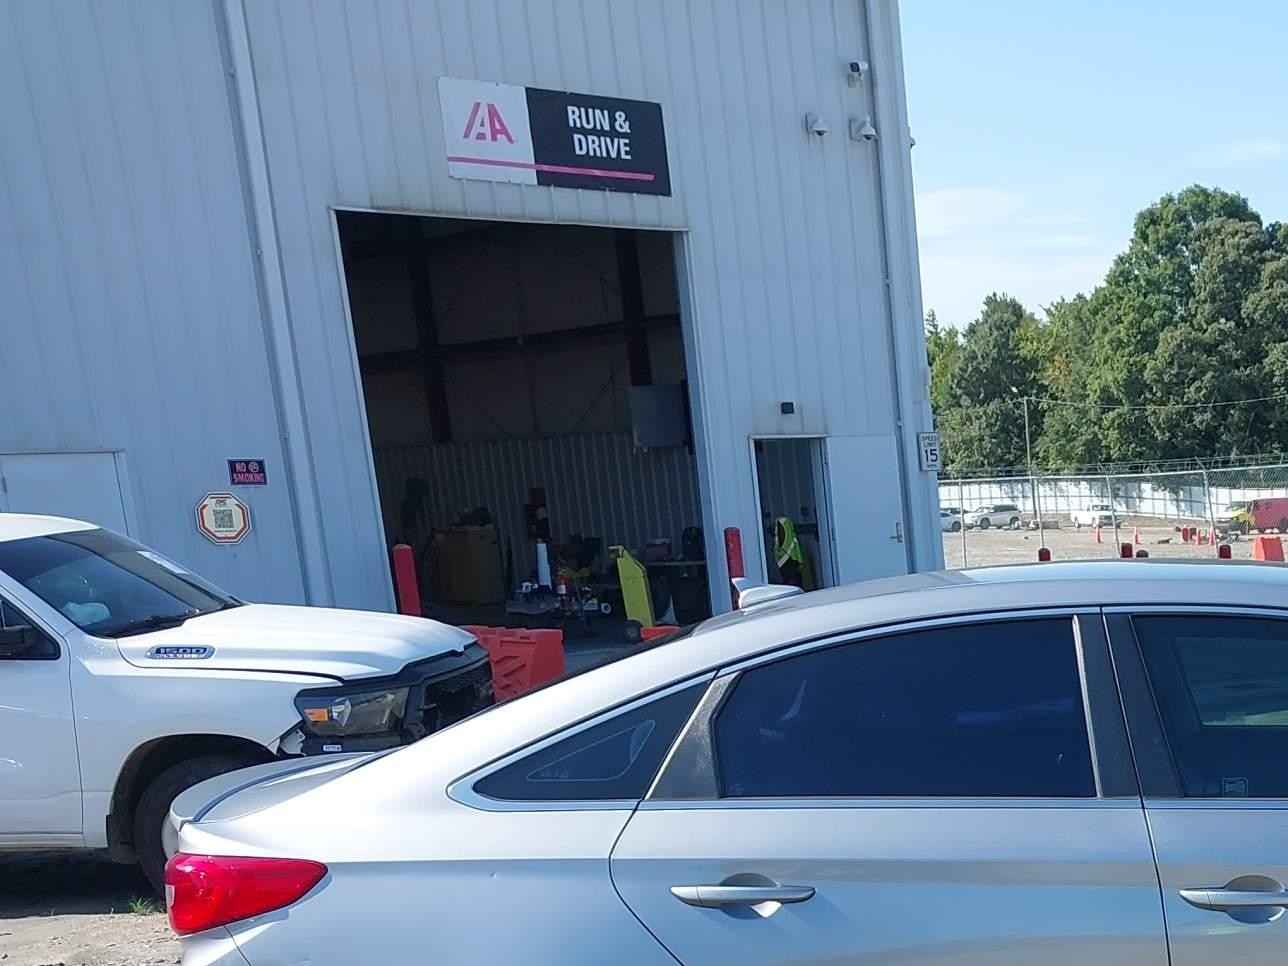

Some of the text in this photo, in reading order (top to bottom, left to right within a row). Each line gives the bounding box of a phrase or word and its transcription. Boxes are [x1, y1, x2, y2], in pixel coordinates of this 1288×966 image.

[566, 105, 632, 134] RUN &
[573, 133, 632, 160] DRIVE
[925, 448, 938, 463] 15
[235, 462, 246, 473] NO
[233, 473, 265, 483] SMOKING
